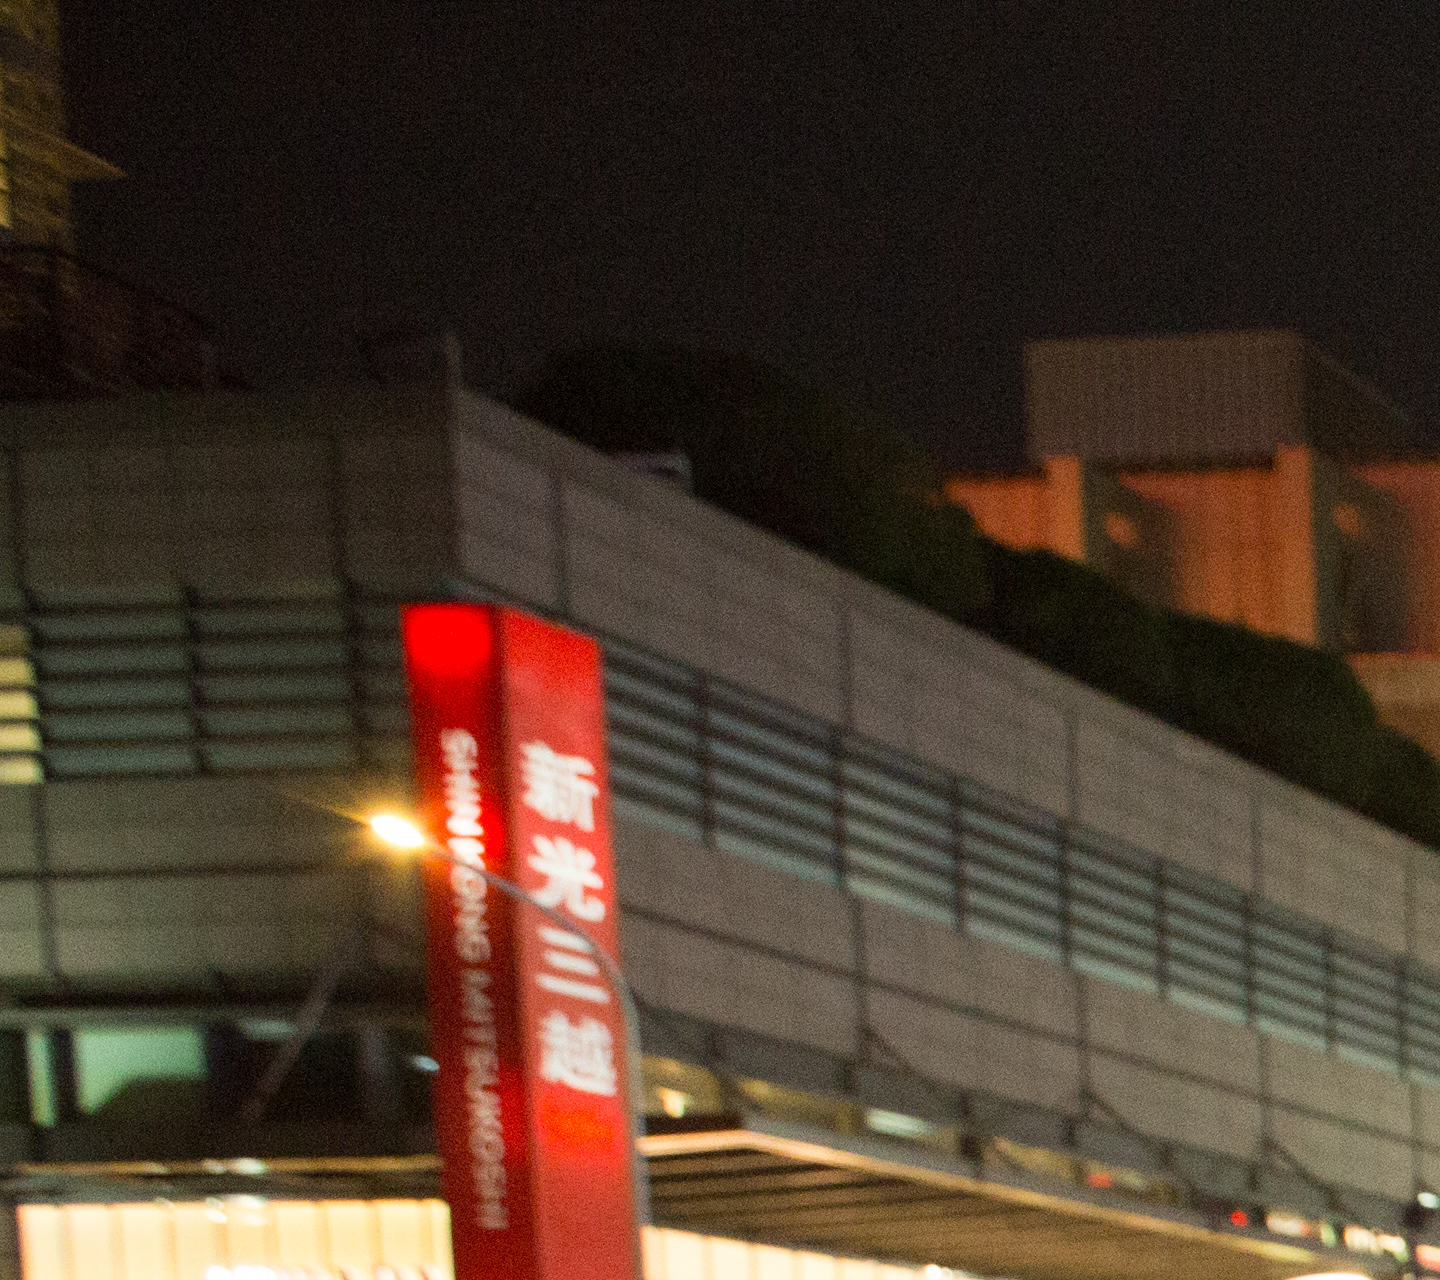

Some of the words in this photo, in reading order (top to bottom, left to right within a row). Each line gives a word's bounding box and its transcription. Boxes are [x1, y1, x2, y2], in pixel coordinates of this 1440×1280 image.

[441, 727, 485, 836] SHIN
[448, 838, 492, 962] KONG
[519, 740, 618, 1098] 新光三越
[461, 967, 509, 1231] MITSUKOSHI
